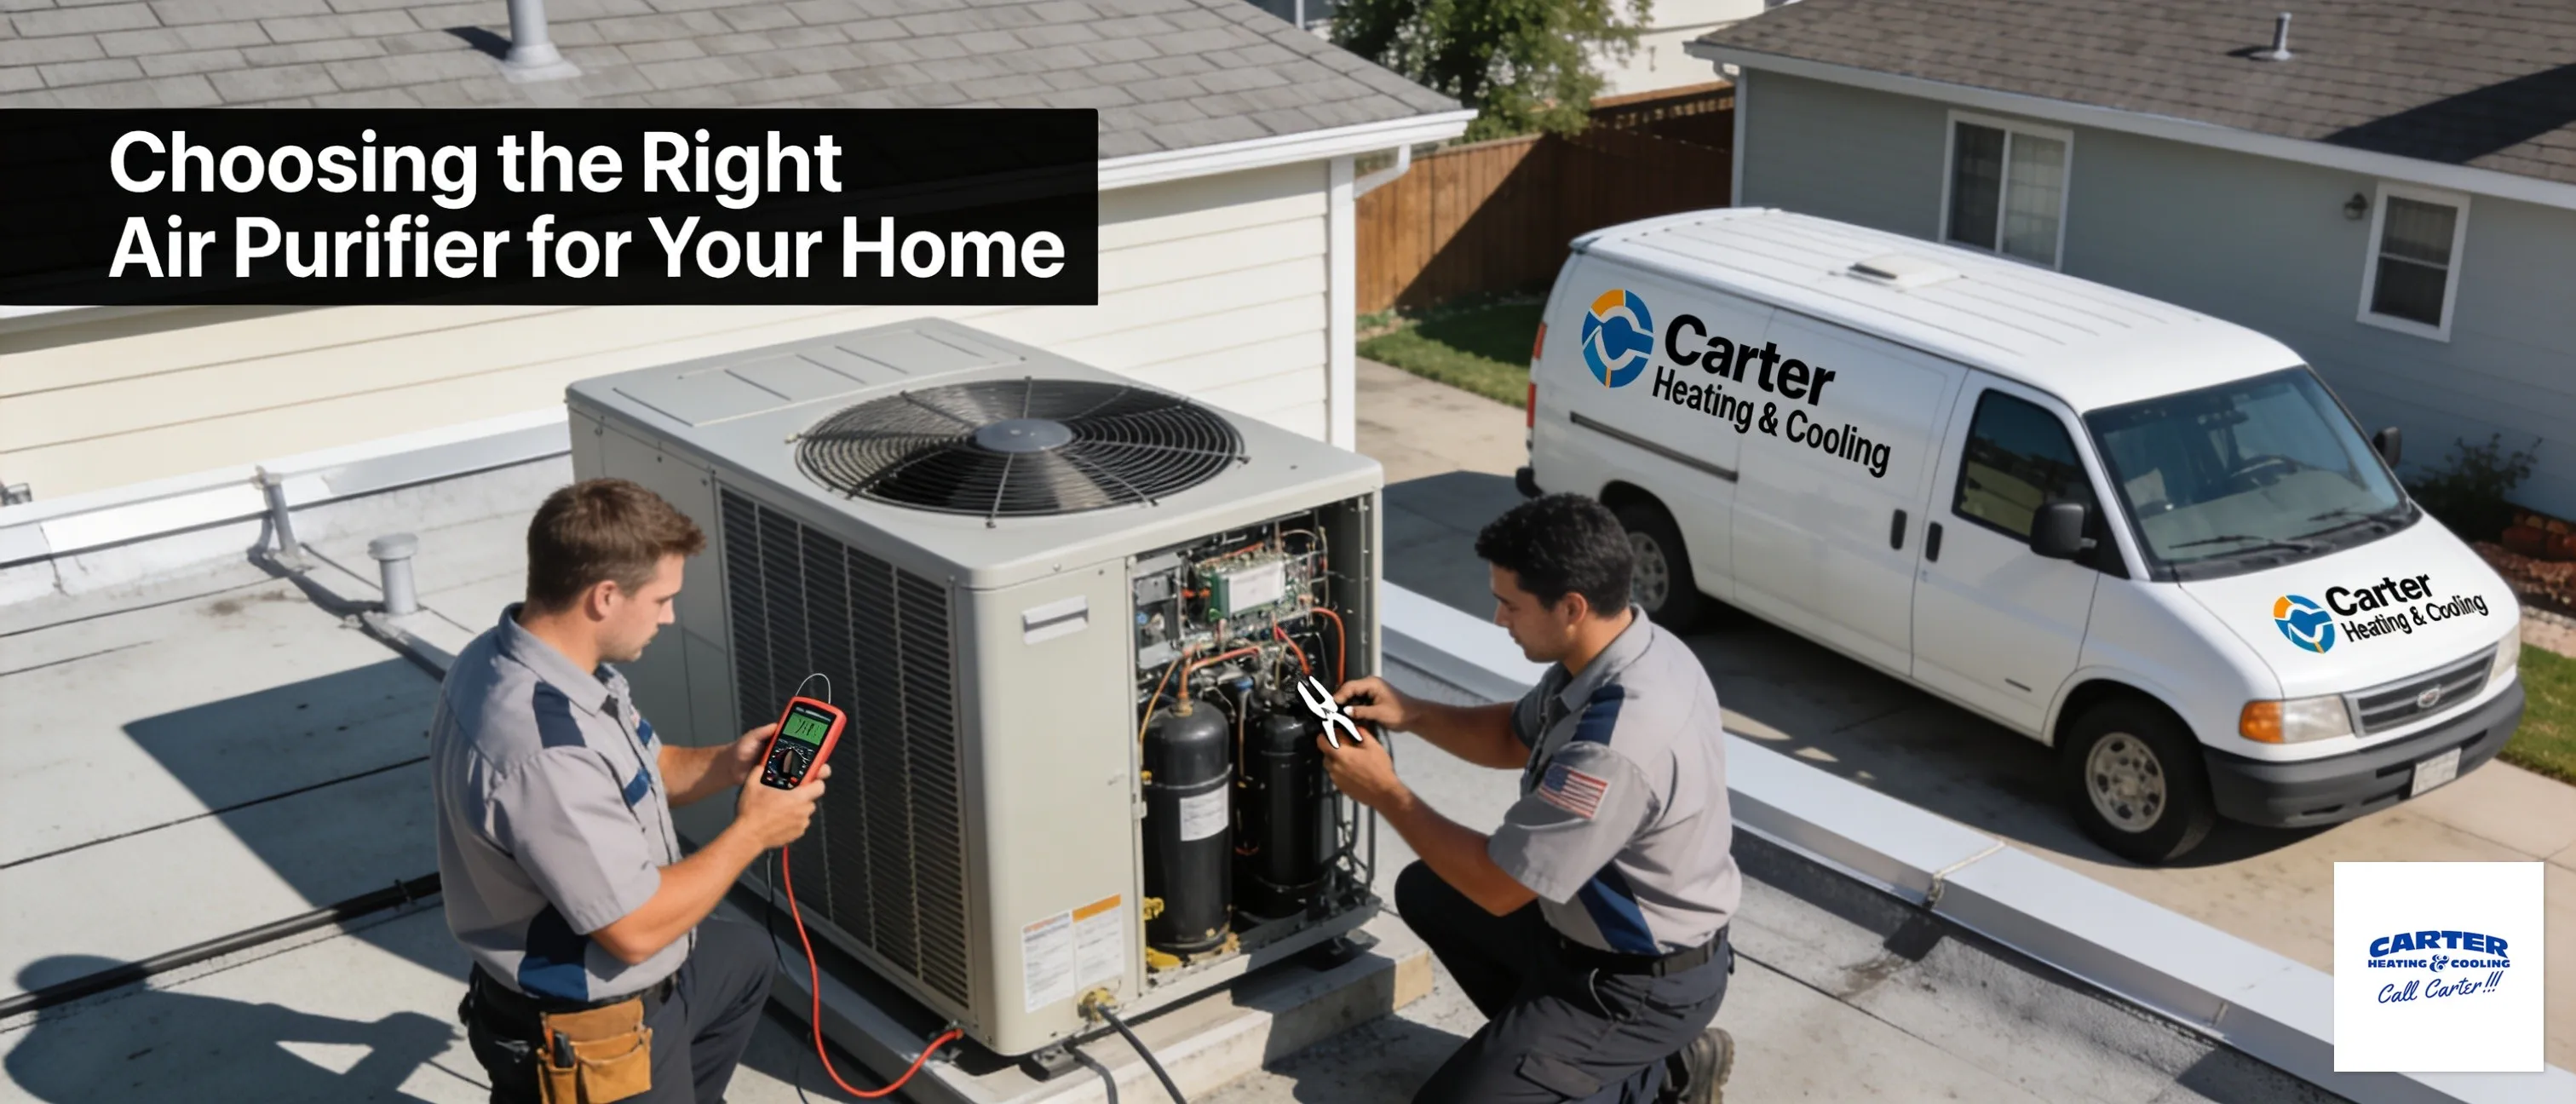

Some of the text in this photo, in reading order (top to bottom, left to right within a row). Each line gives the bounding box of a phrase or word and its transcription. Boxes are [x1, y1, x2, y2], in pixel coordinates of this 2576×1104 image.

[1665, 313, 1837, 406] Carter
[1652, 365, 1891, 479] Heating & Cooling
[2325, 573, 2433, 617] Carter
[2341, 595, 2489, 642] Heating & Cooling
